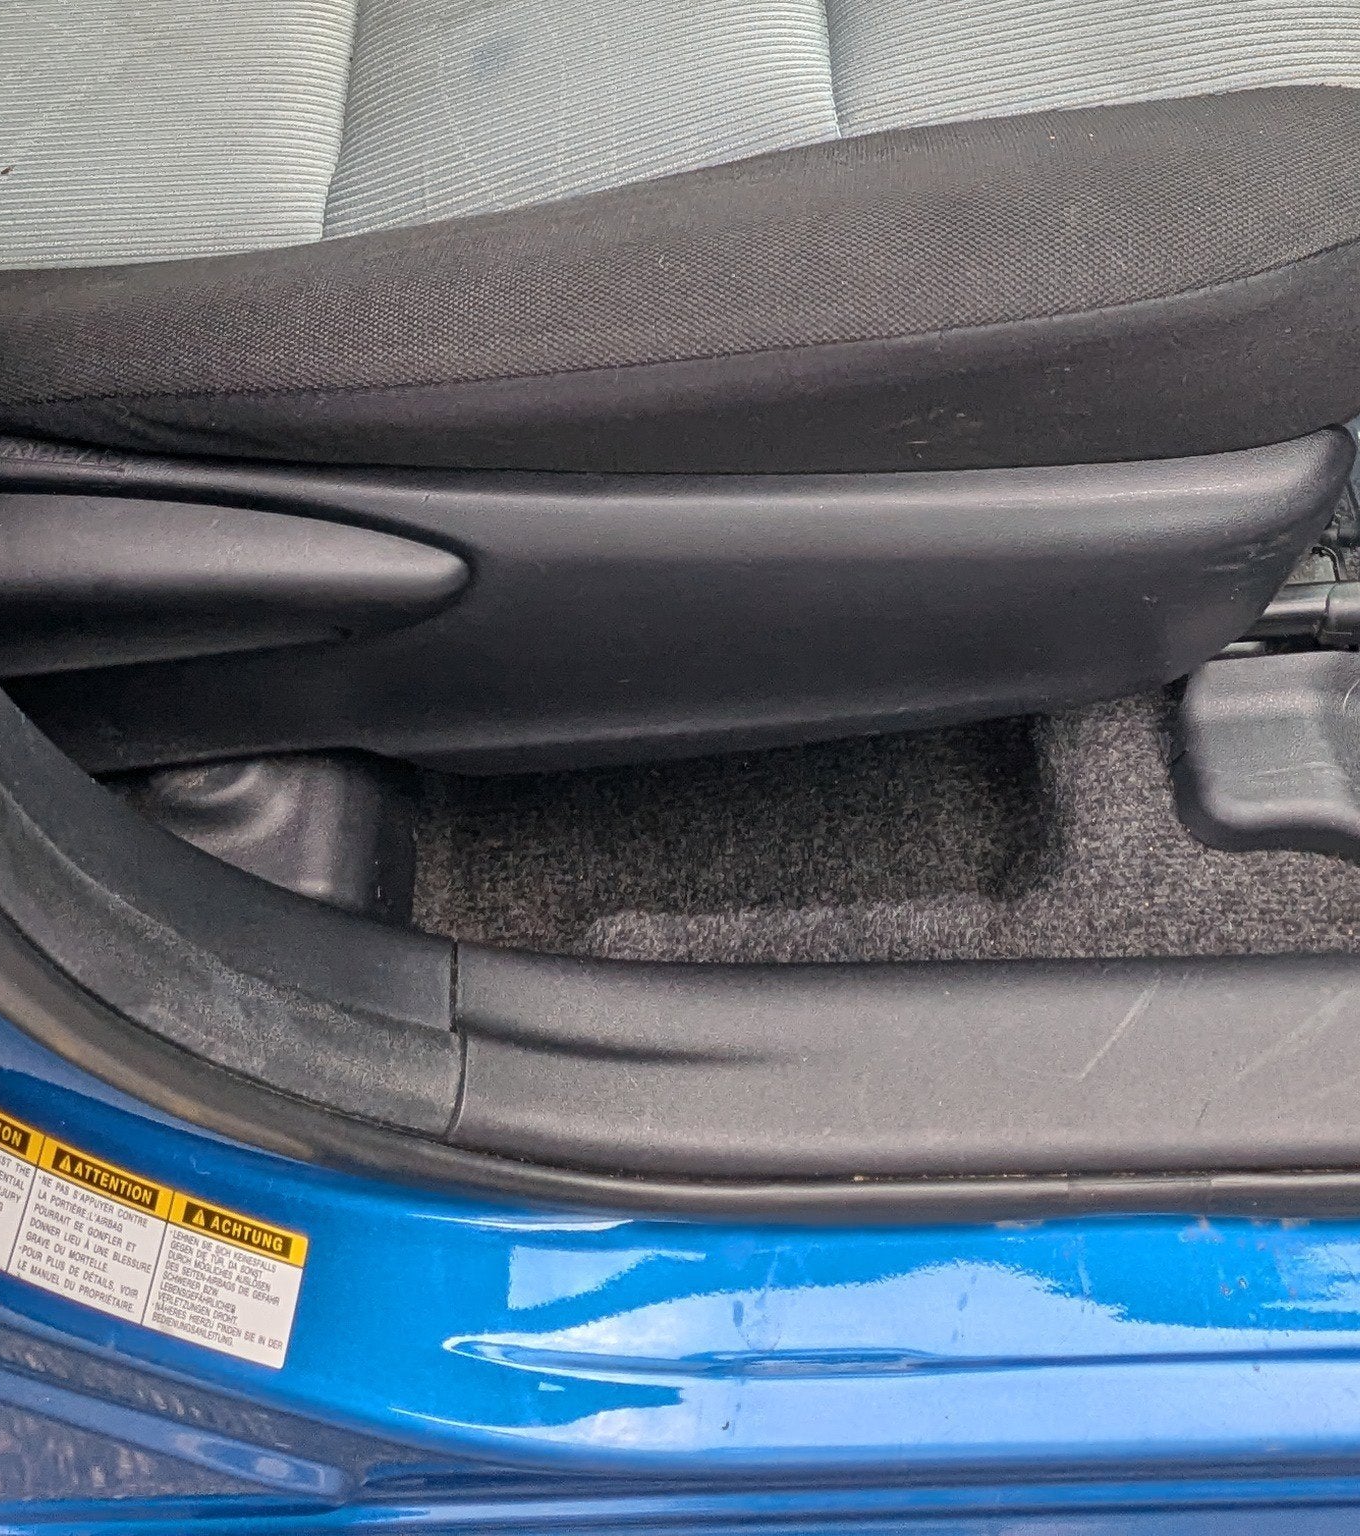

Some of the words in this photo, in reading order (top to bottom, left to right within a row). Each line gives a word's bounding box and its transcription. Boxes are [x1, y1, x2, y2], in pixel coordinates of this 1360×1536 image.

[15, 1161, 32, 1177] THE
[74, 1162, 153, 1205] ATTENTION
[38, 1190, 47, 1201] LA
[55, 1180, 69, 1195] PAS
[72, 1187, 114, 1214] S'APPUYER
[118, 1208, 150, 1228] CONTRE
[25, 1231, 51, 1249] GRAVE
[53, 1244, 66, 1255] OU
[29, 1217, 61, 1237] DONNER
[63, 1232, 81, 1246] LIEU
[93, 1244, 109, 1259] UNE
[112, 1250, 152, 1275] BLESSURE
[33, 1203, 71, 1227] POURRAIT
[87, 1226, 122, 1247] GONFLER
[125, 1241, 137, 1252] ET
[209, 1216, 284, 1252] ACHTUNG
[17, 1259, 26, 1272] LE
[30, 1265, 59, 1286] MANUEL
[63, 1278, 76, 1291] DU
[45, 1254, 65, 1271] PLUS
[68, 1264, 79, 1278] DE
[120, 1284, 139, 1299] VOIR
